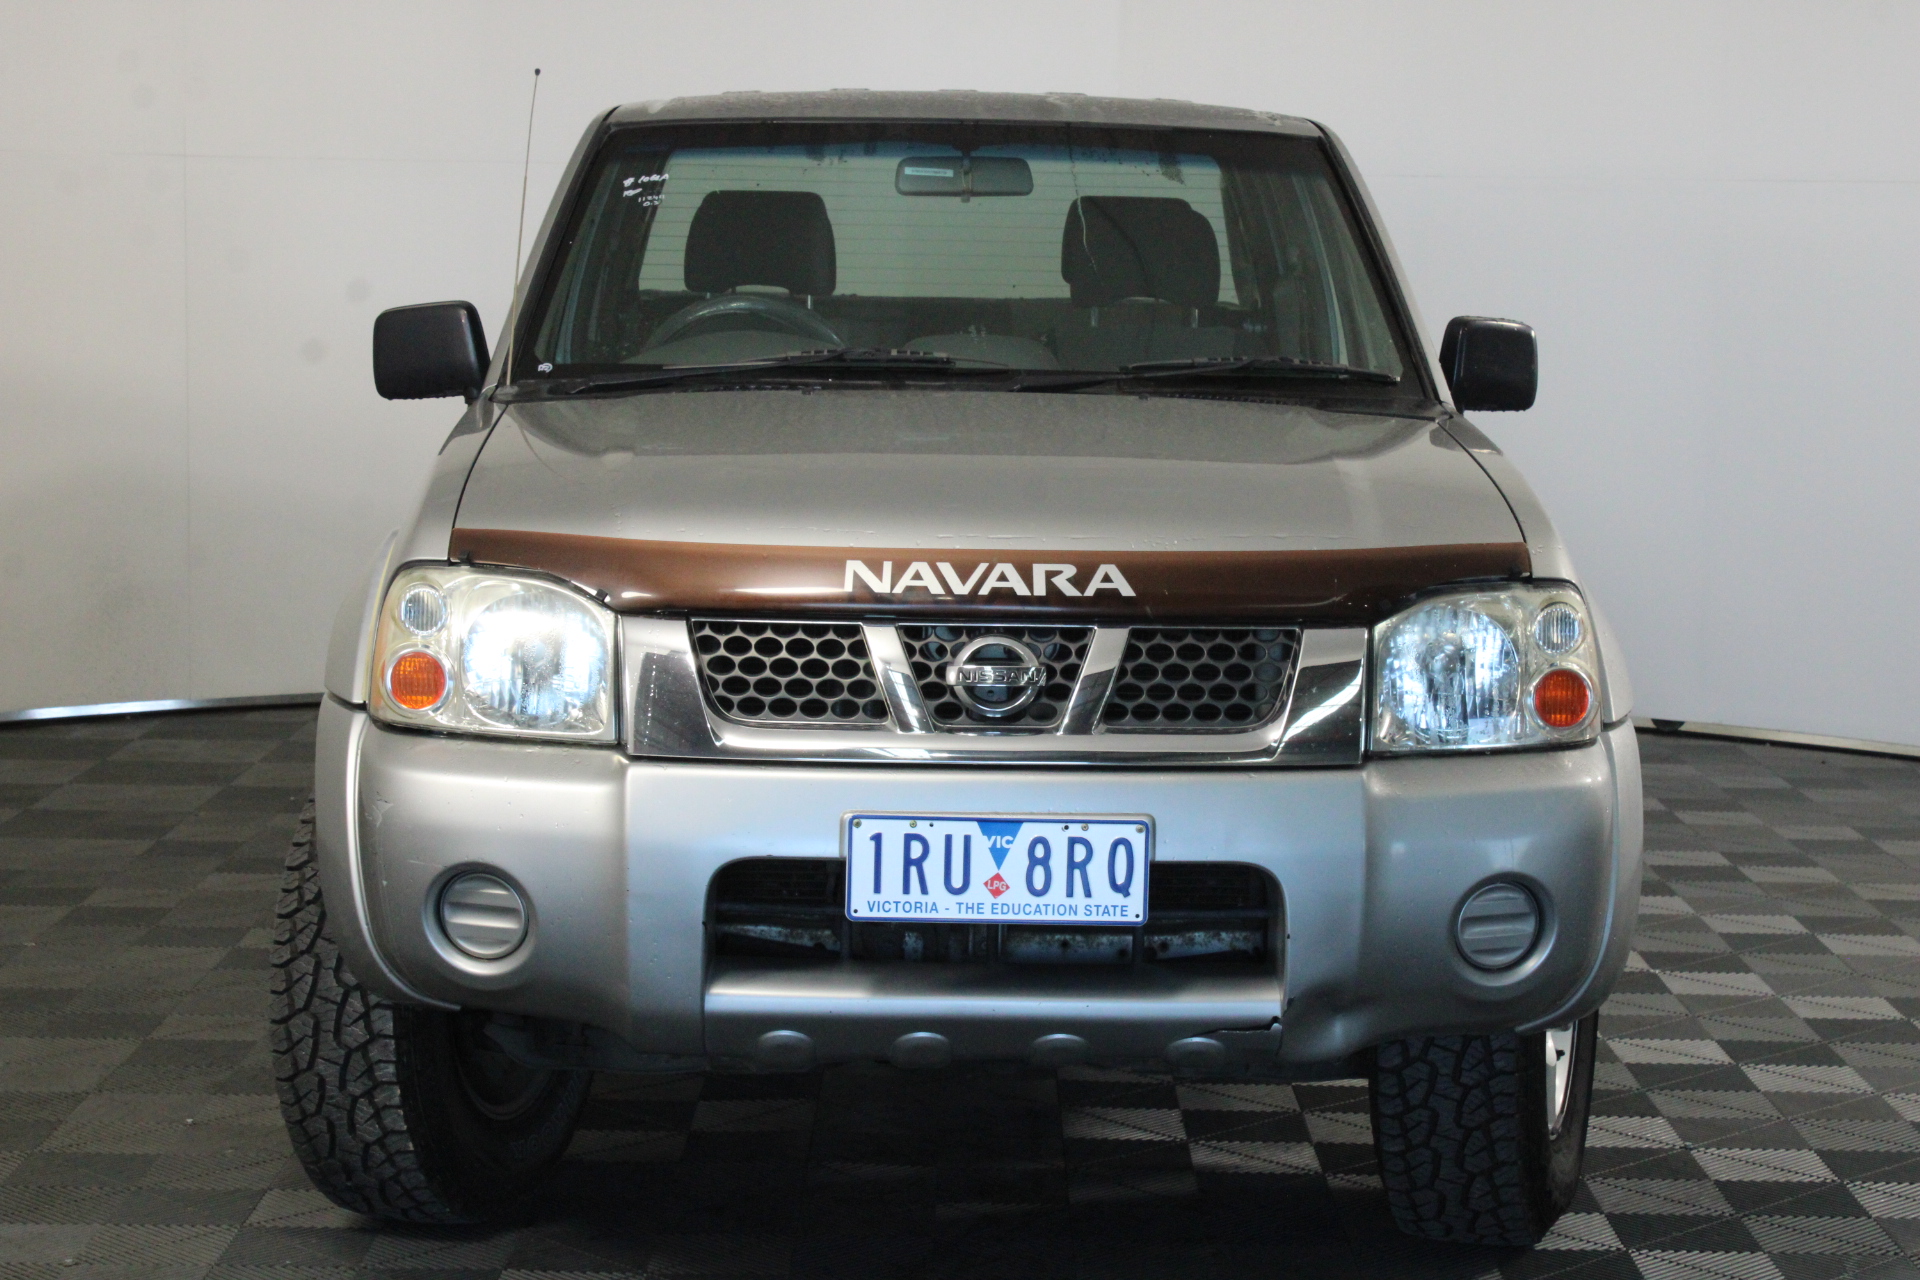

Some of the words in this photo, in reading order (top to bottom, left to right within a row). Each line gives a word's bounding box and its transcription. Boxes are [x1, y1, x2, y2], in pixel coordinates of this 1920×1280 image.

[844, 560, 1136, 597] NAVARA
[959, 670, 1037, 683] NISSAN
[983, 835, 1014, 849] VIC
[869, 832, 972, 896] 1RU
[1025, 835, 1135, 898] 8RQ
[987, 880, 1008, 892] LPG
[867, 900, 939, 914] VICTORIA
[956, 902, 985, 915] THE
[991, 903, 1078, 916] EDUCATION
[1084, 904, 1129, 917] STATE
